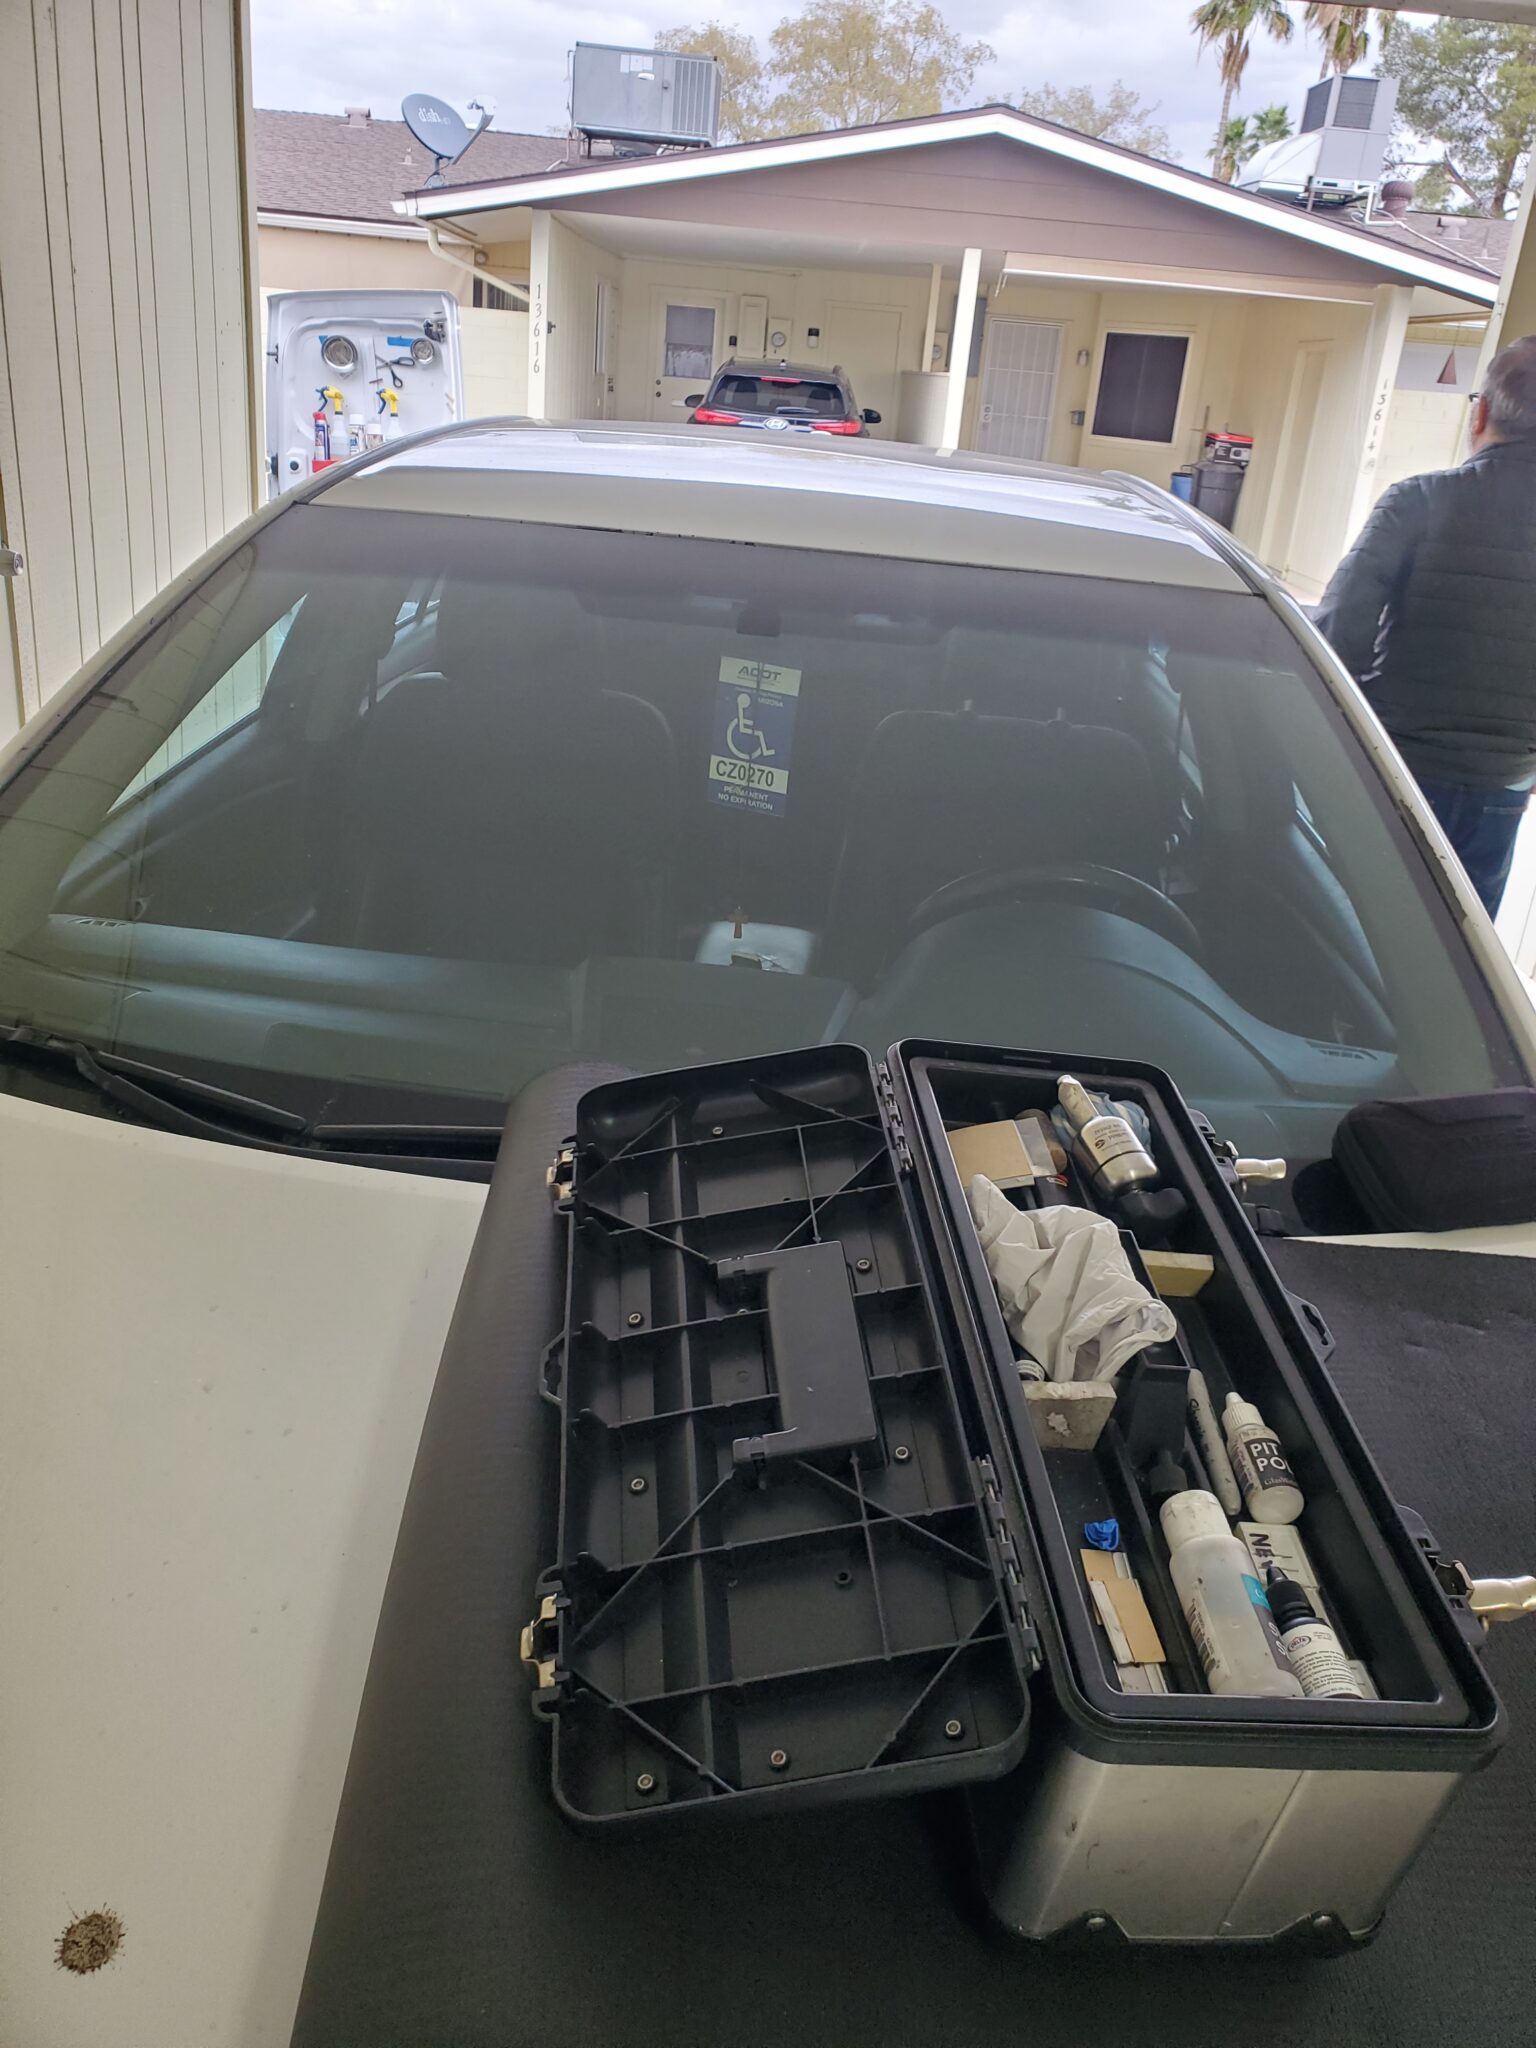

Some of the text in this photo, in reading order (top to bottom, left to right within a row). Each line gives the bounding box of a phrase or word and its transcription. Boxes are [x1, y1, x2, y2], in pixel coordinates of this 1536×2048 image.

[418, 107, 441, 122] dish
[533, 283, 542, 374] 13616
[716, 760, 775, 788] CZ0270
[718, 792, 730, 801] NO
[724, 785, 769, 801] PERMNENT
[1249, 1441, 1279, 1457] PIT
[1256, 1456, 1294, 1475] PO
